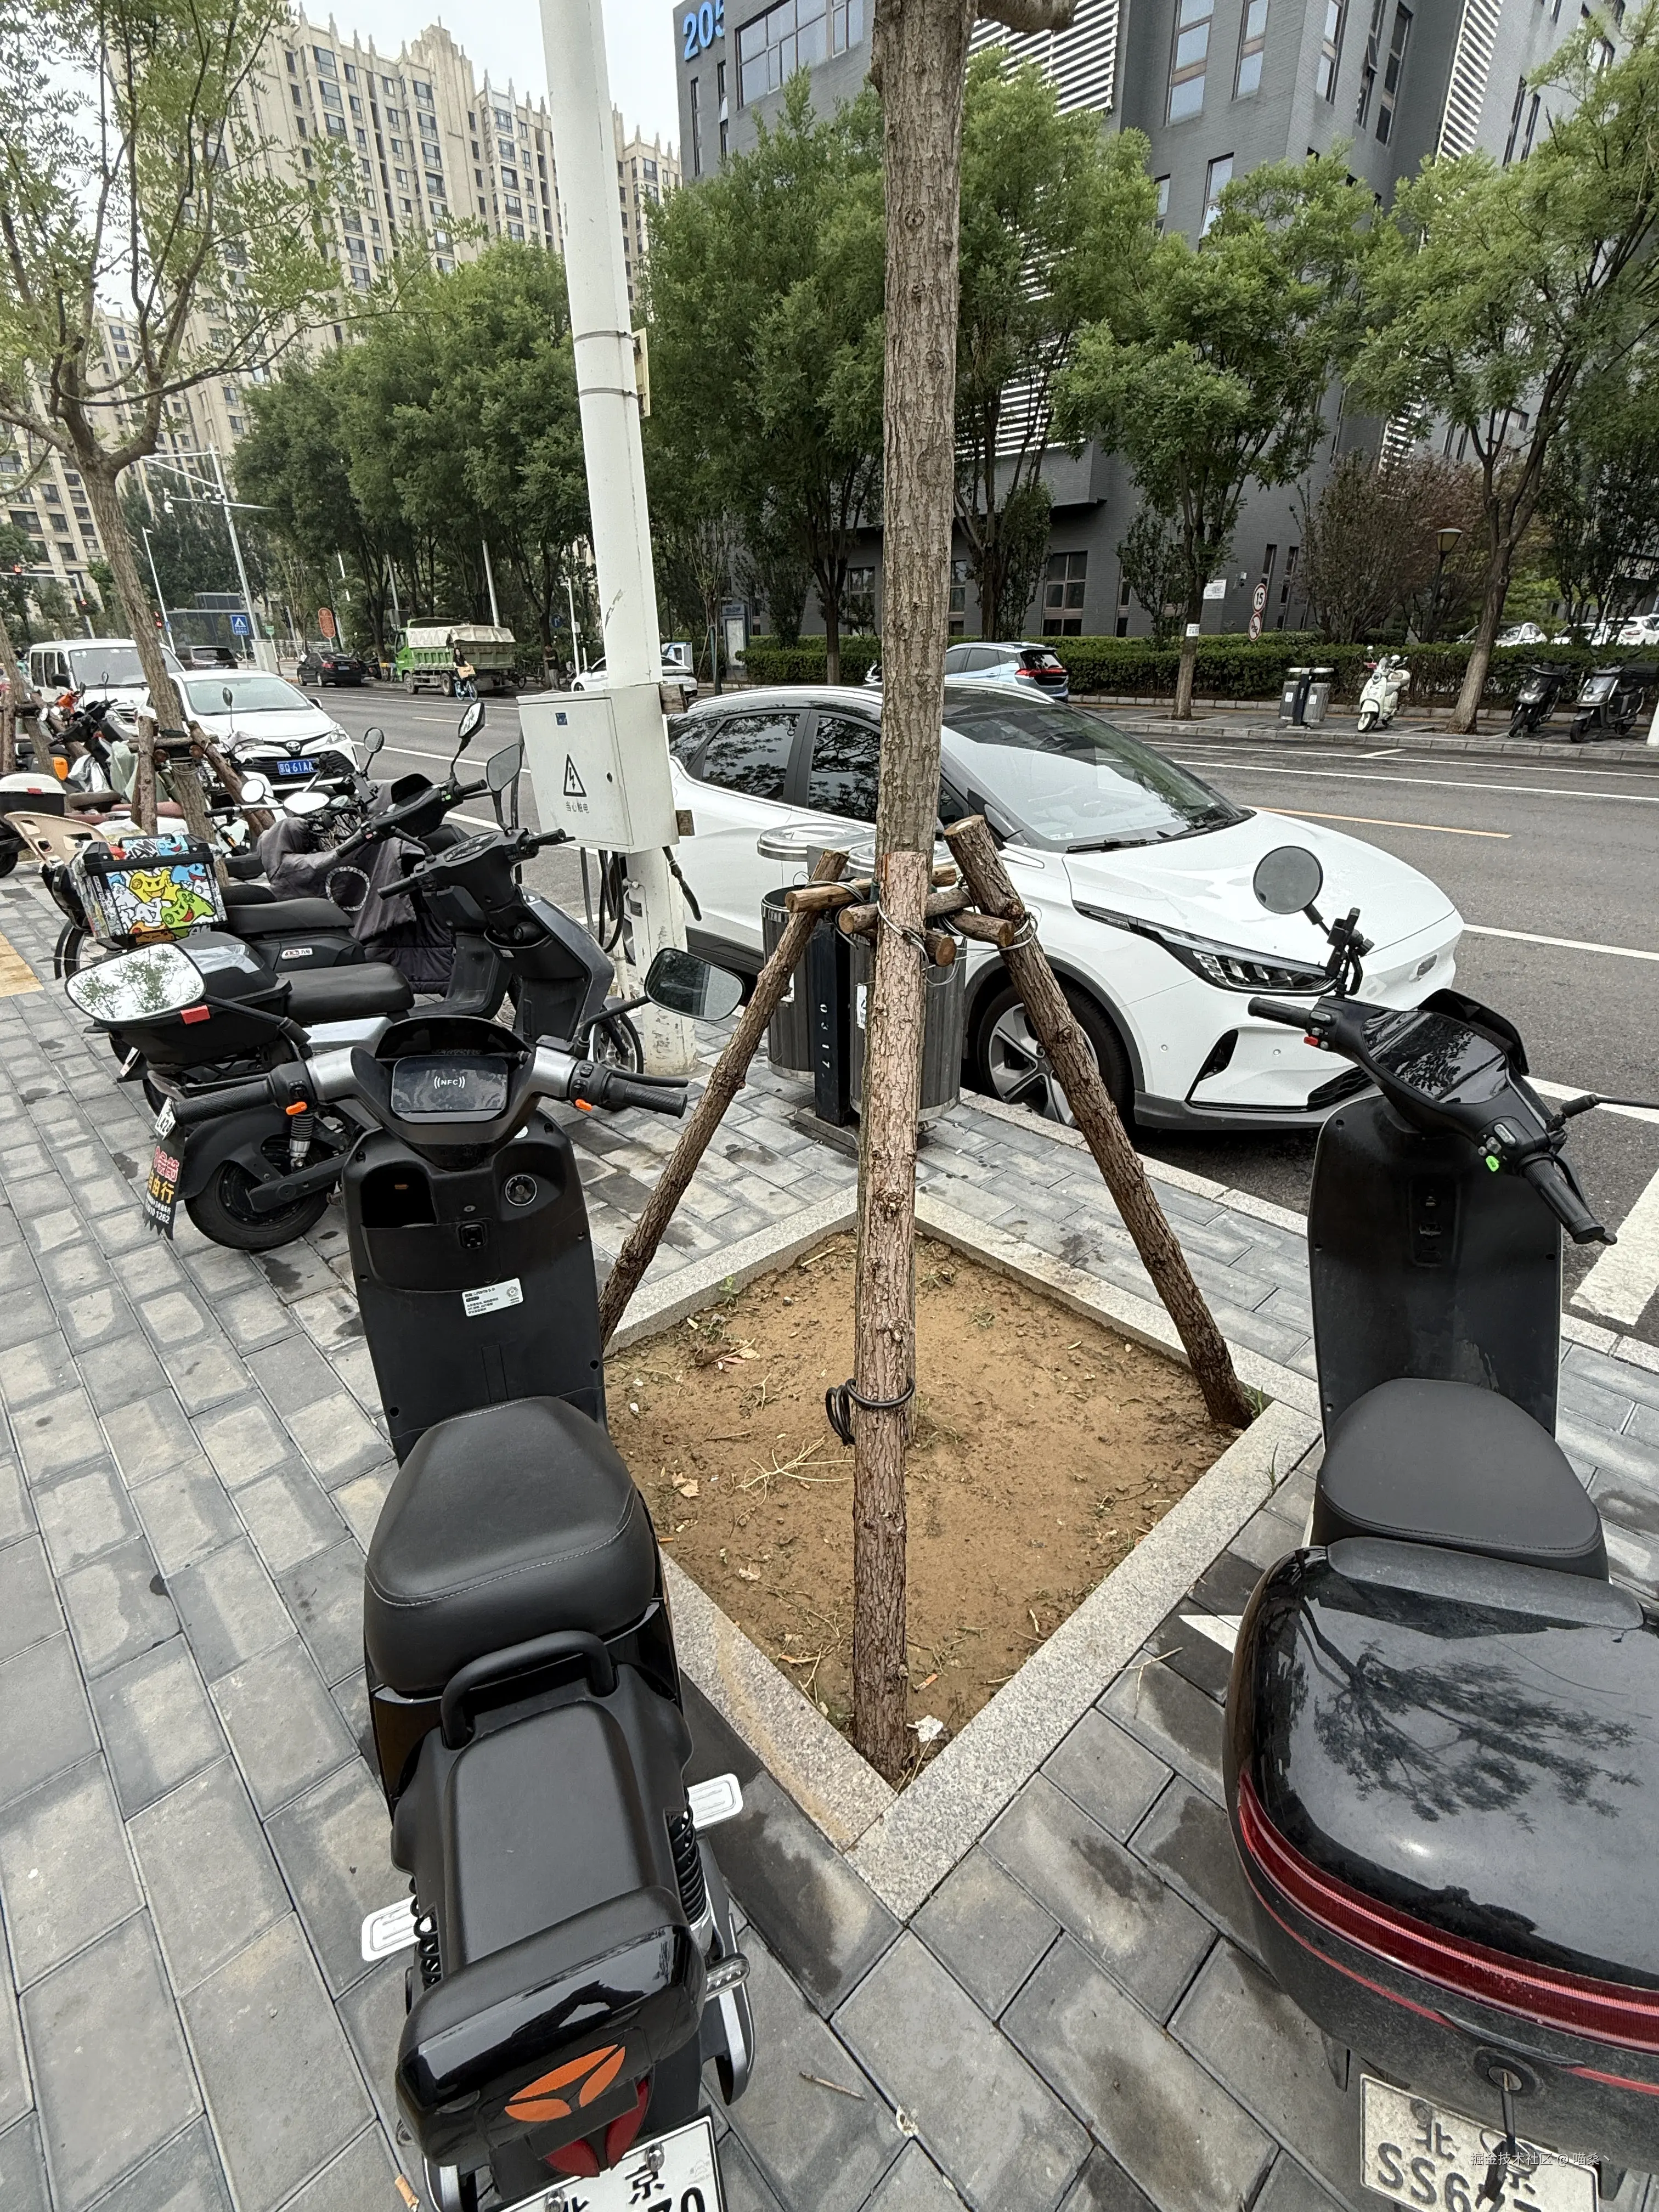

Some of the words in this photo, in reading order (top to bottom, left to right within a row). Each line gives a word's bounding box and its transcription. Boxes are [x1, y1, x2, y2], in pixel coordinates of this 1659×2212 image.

[1256, 592, 1263, 605] 15
[565, 801, 590, 814] 当心触电
